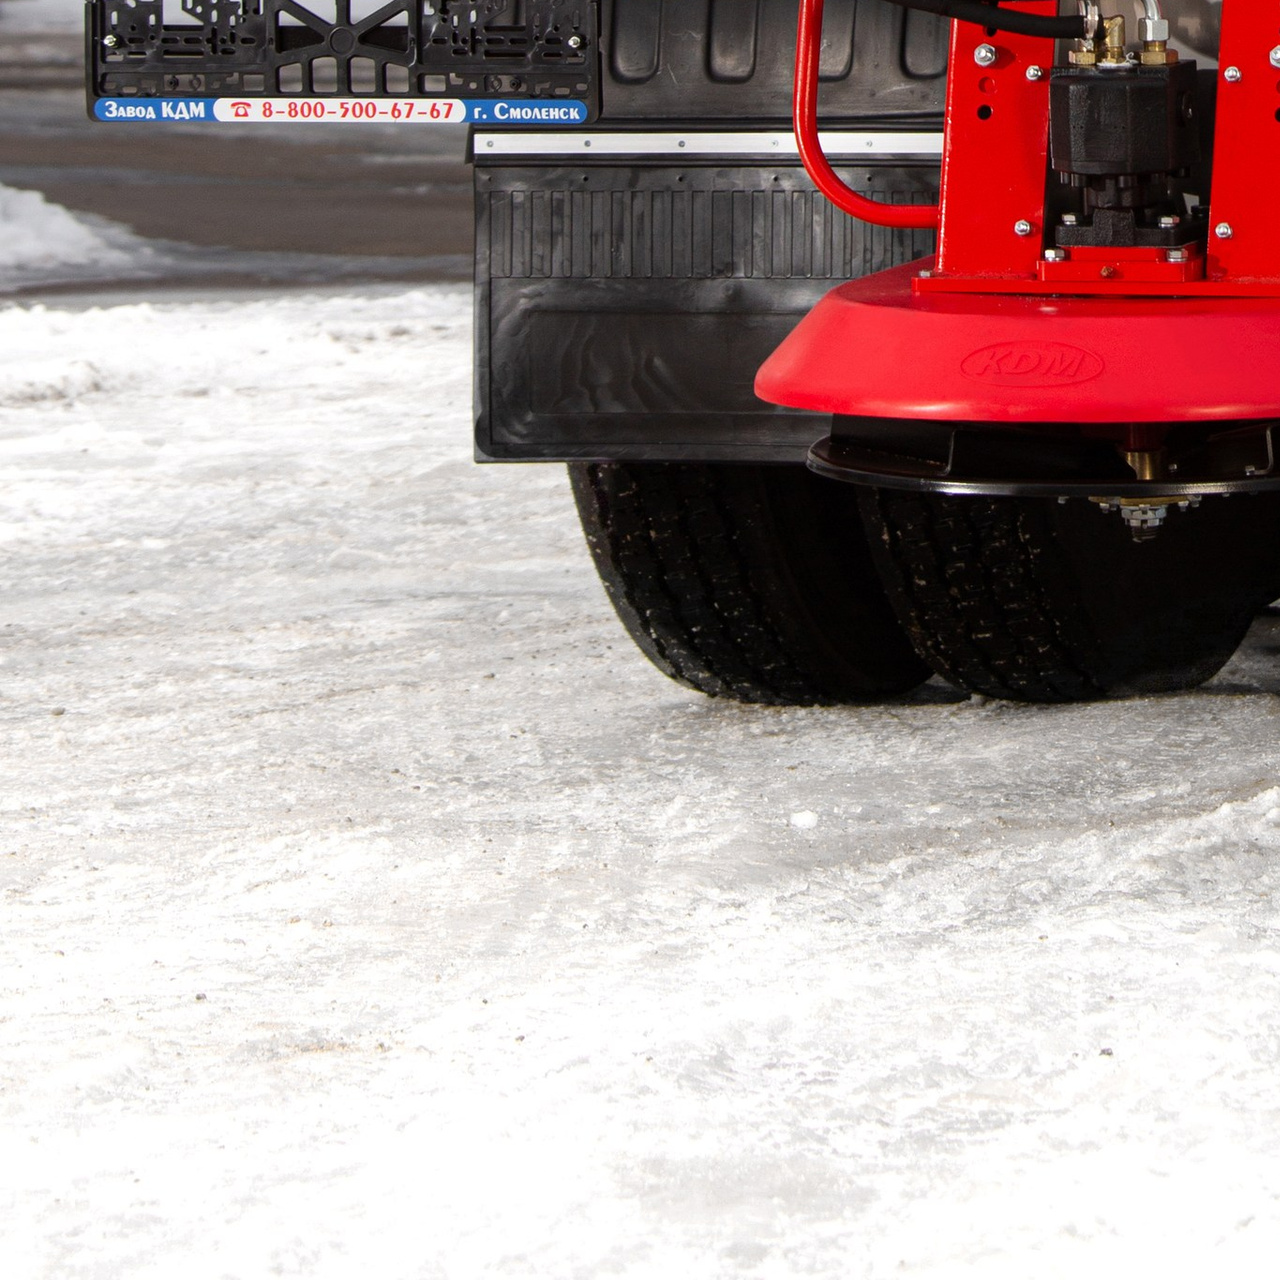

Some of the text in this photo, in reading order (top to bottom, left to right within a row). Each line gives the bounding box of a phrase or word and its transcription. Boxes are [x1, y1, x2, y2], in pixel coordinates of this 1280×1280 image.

[161, 101, 206, 120] КДМ
[261, 101, 454, 120] 8-800-500-67-67
[473, 107, 488, 120] г.
[975, 351, 1085, 377] KDM
